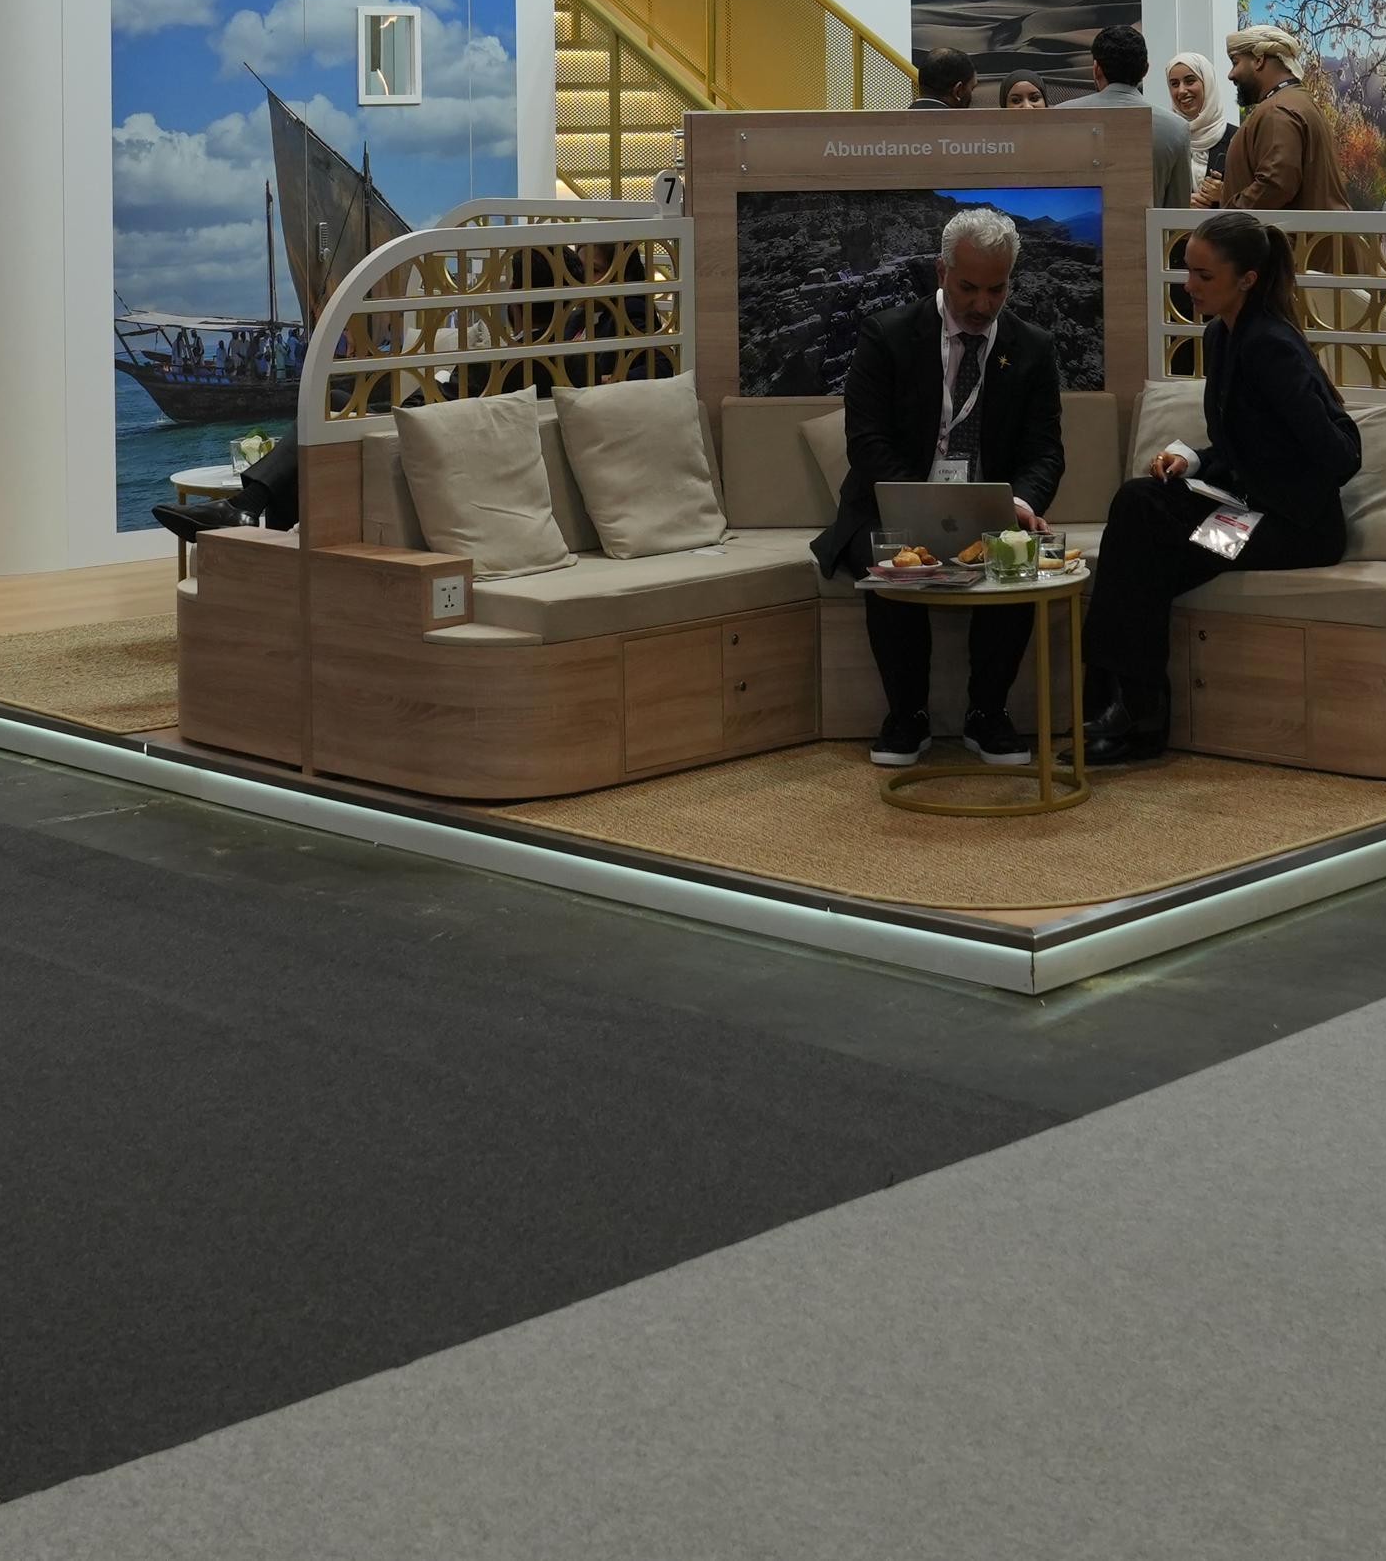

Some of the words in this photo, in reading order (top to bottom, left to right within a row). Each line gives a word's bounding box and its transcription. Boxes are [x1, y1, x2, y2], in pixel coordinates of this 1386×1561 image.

[824, 140, 932, 157] Abundance
[938, 138, 1015, 155] Tourism
[664, 177, 676, 204] 7
